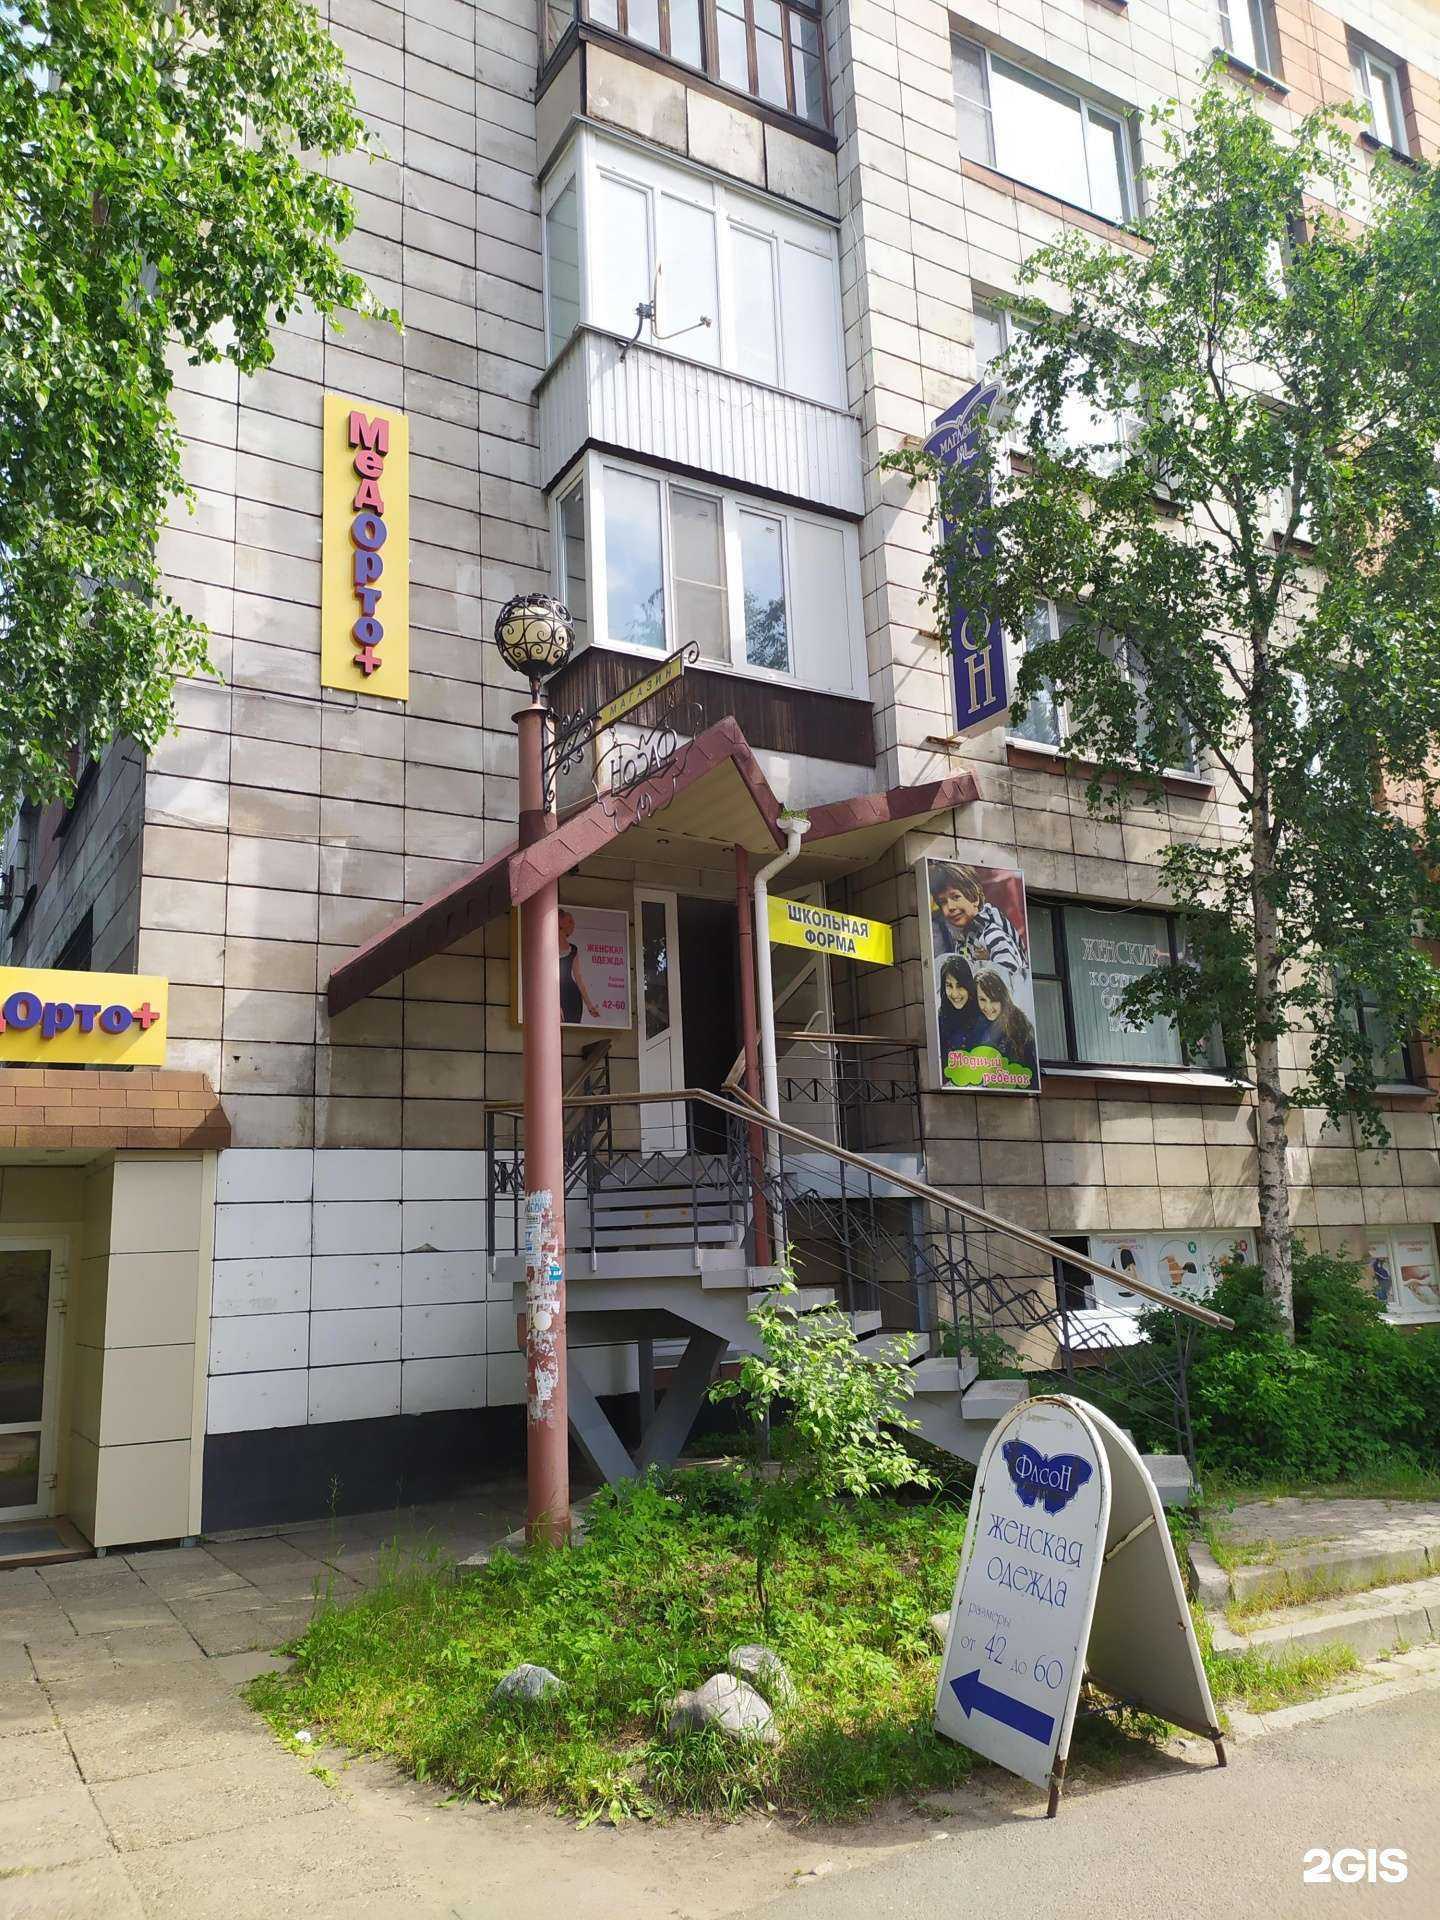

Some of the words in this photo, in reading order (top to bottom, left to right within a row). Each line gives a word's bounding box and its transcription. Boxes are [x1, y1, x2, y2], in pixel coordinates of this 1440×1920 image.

[609, 666, 673, 716] МАГАЗИН
[787, 904, 869, 938] ШКОЛЬНАЯ
[804, 929, 856, 954] ФОРМА
[1081, 937, 1159, 968] ЖЕНСКИЕ
[592, 955, 624, 966] ОДЕЖДА
[0, 991, 160, 1039] Орто+
[602, 1000, 625, 1010] 42-60
[985, 1633, 1007, 1664] 42
[1034, 1654, 1063, 1689] 60
